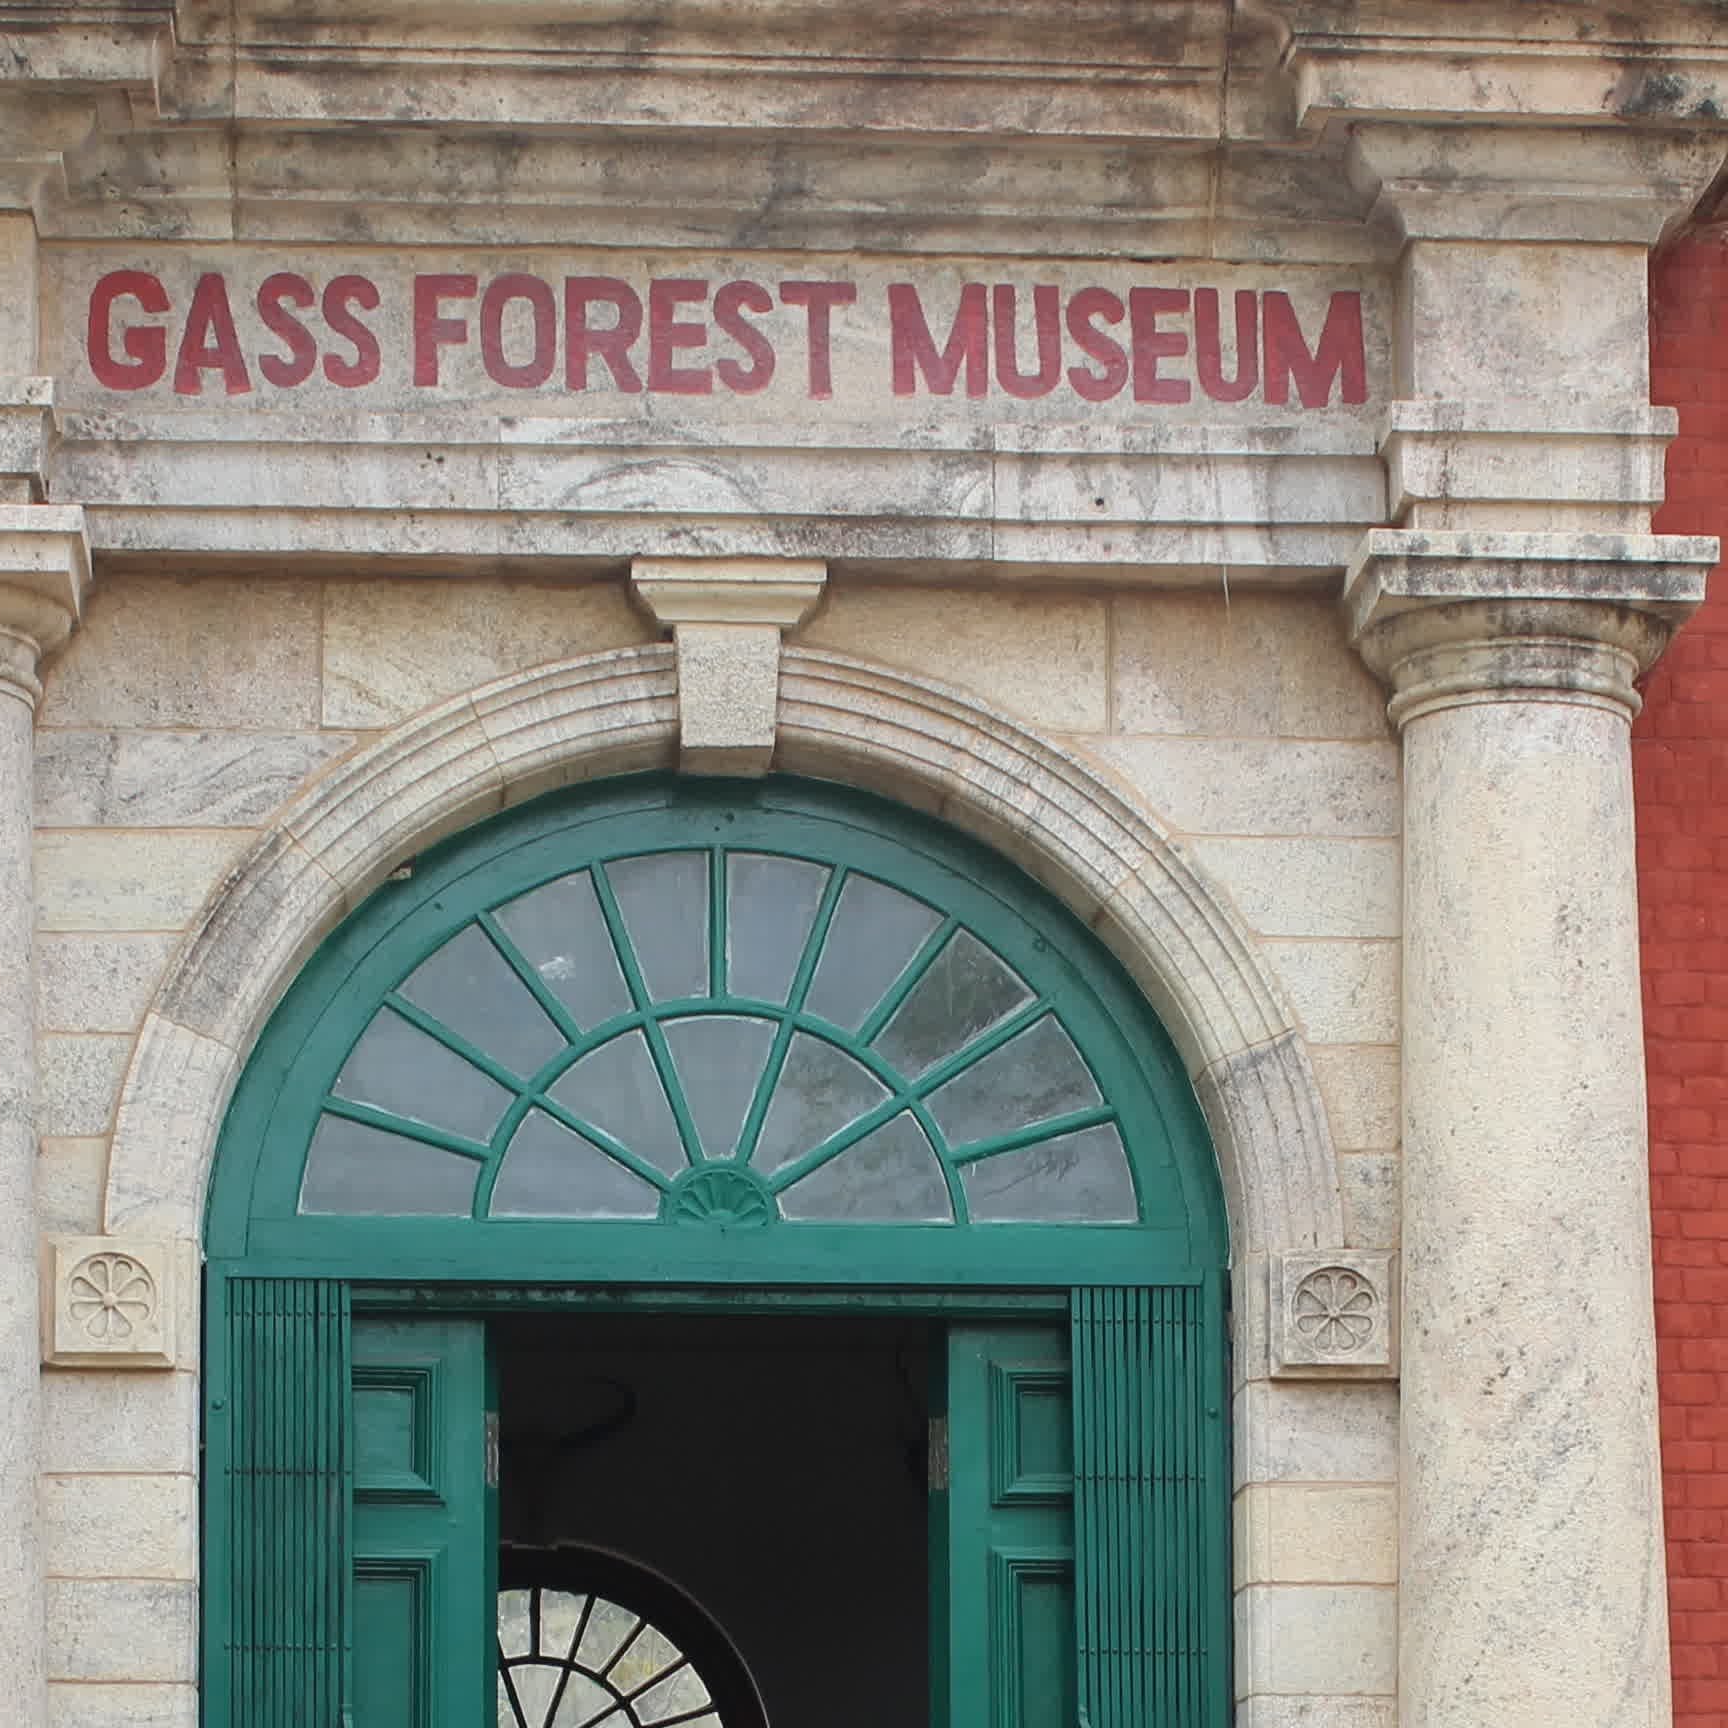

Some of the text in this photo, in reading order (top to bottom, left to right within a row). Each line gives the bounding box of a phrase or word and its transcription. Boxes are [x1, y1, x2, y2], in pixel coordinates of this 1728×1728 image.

[87, 270, 1369, 408] GASS FOREST MUSEUM
